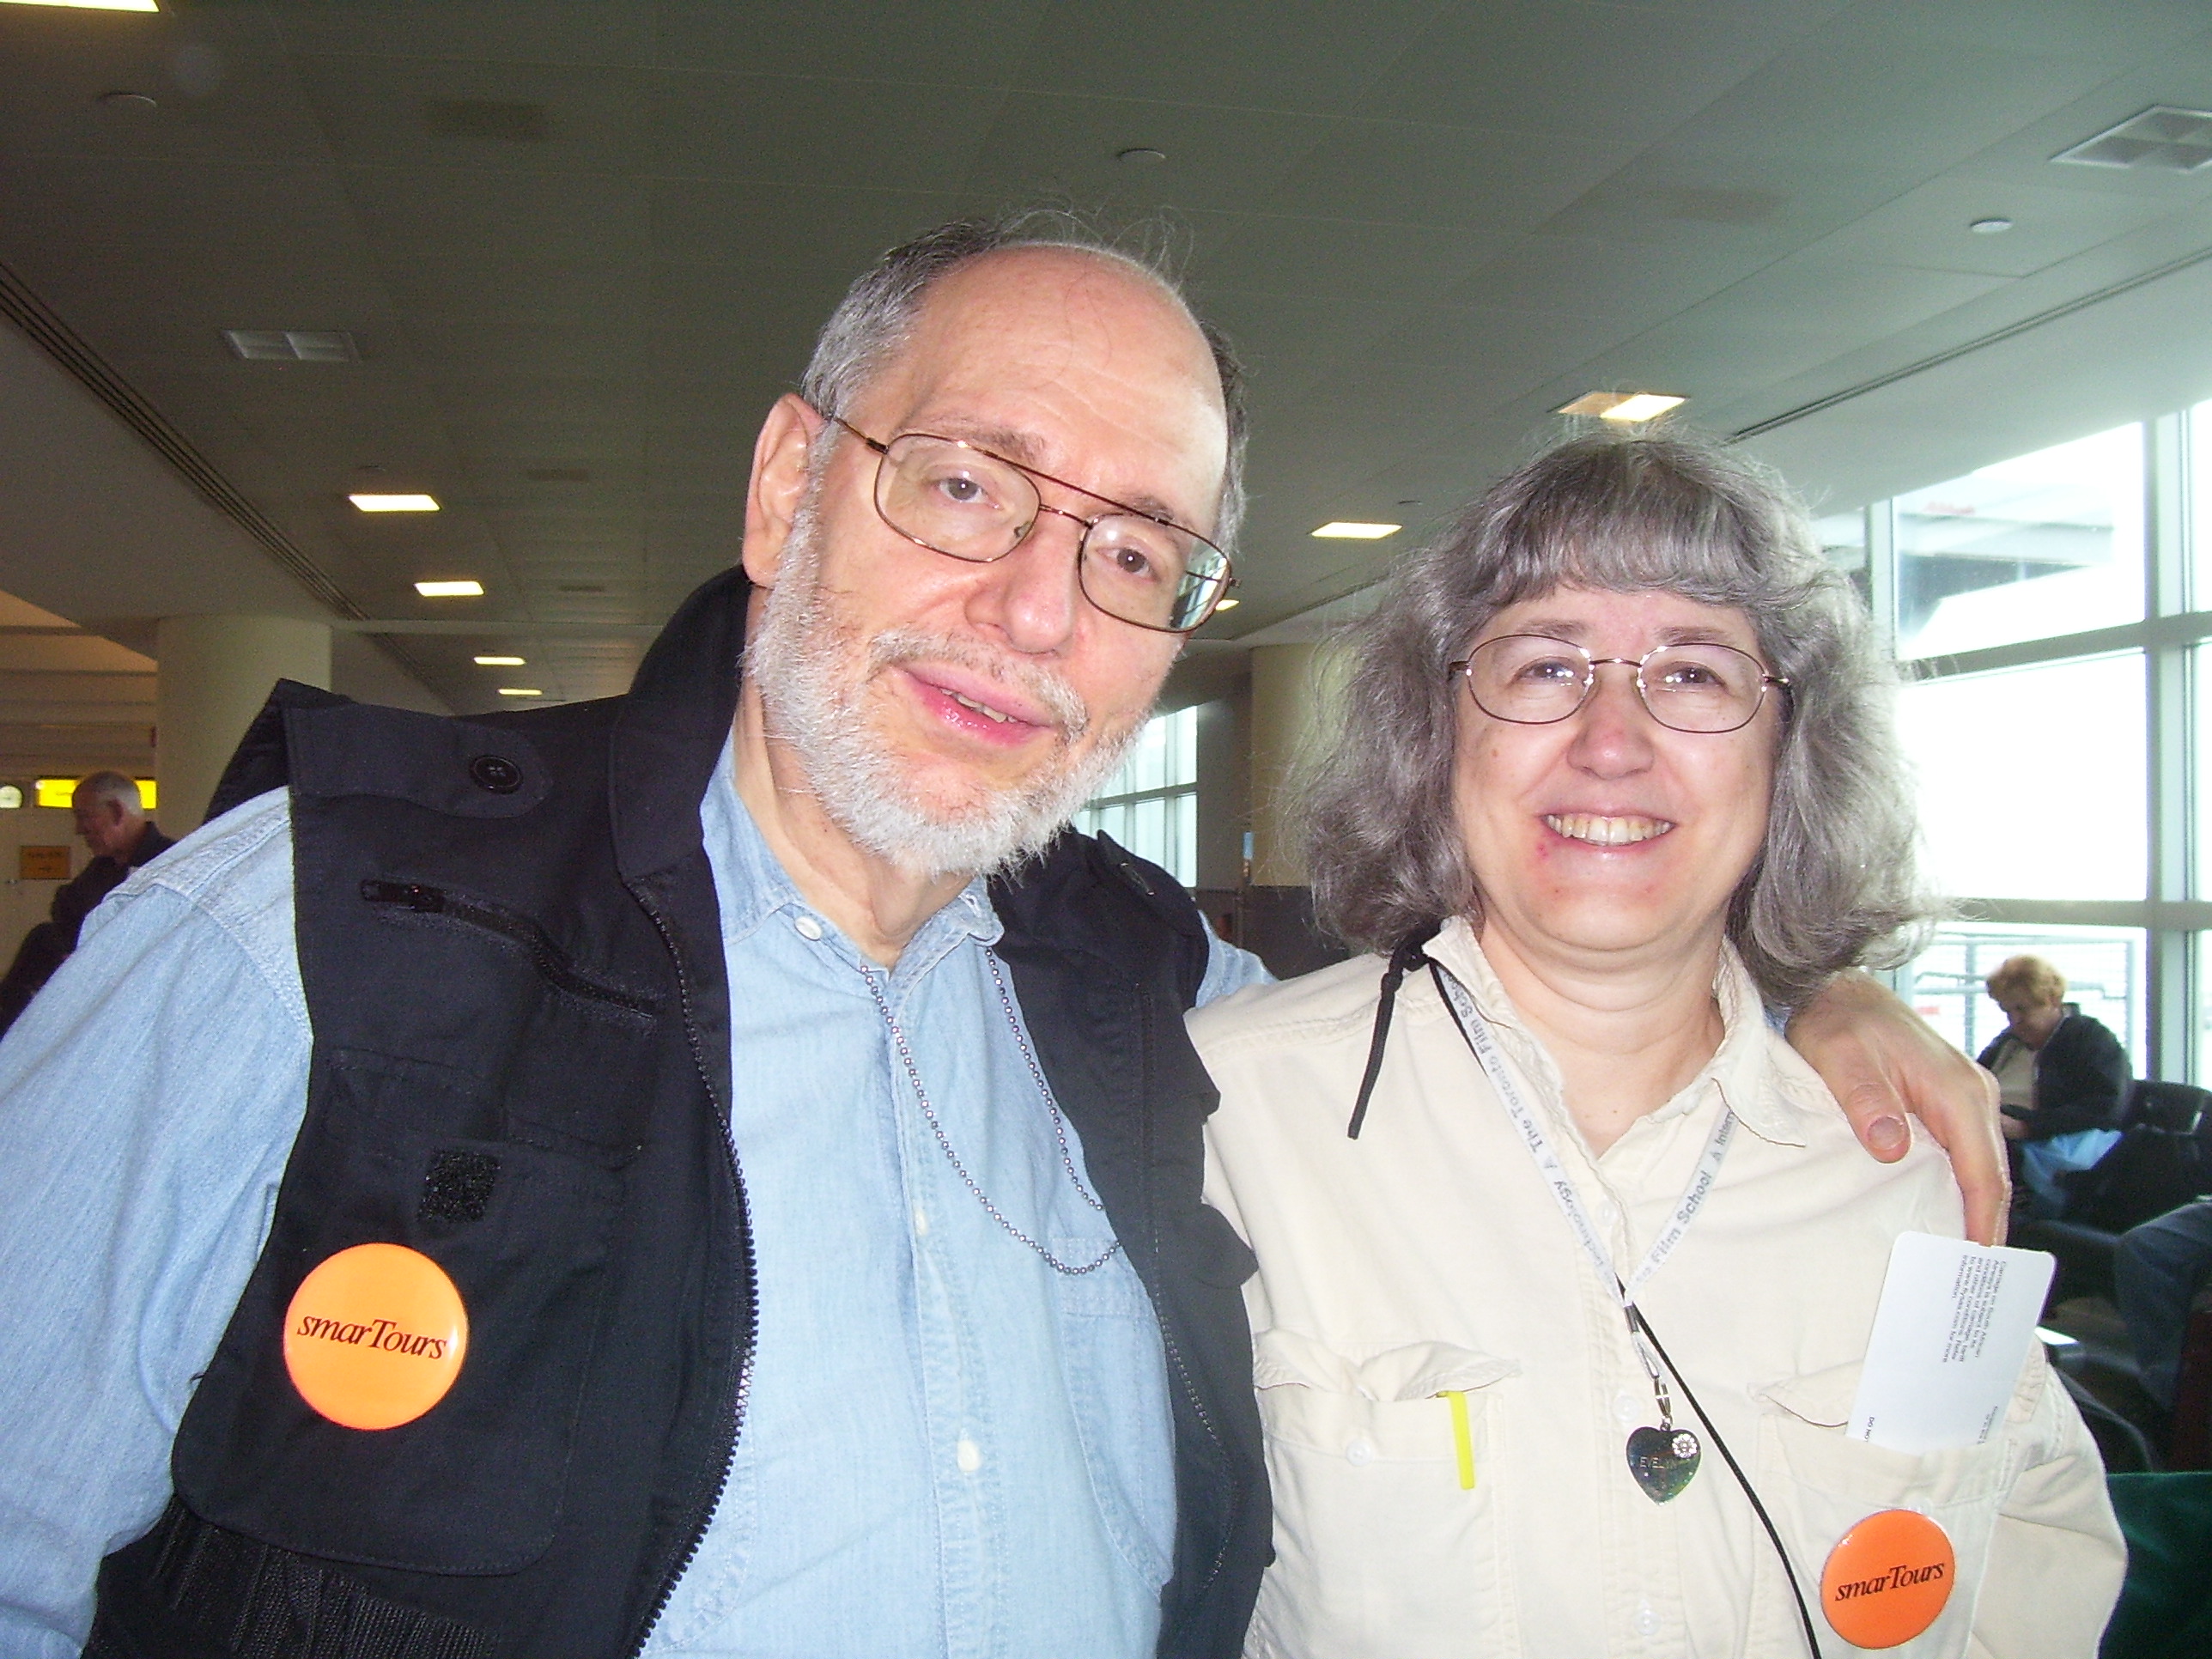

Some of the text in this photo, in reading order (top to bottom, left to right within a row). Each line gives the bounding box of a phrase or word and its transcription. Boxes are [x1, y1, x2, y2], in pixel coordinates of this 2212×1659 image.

[1466, 1018, 1493, 1054] Film
[1484, 1054, 1526, 1119] Toronto
[1516, 1117, 1546, 1153] The
[1648, 1169, 1713, 1266] Film School
[296, 1315, 448, 1359] smarTours
[1867, 1415, 1875, 1428] DO
[1834, 1562, 1945, 1601] smarTours
